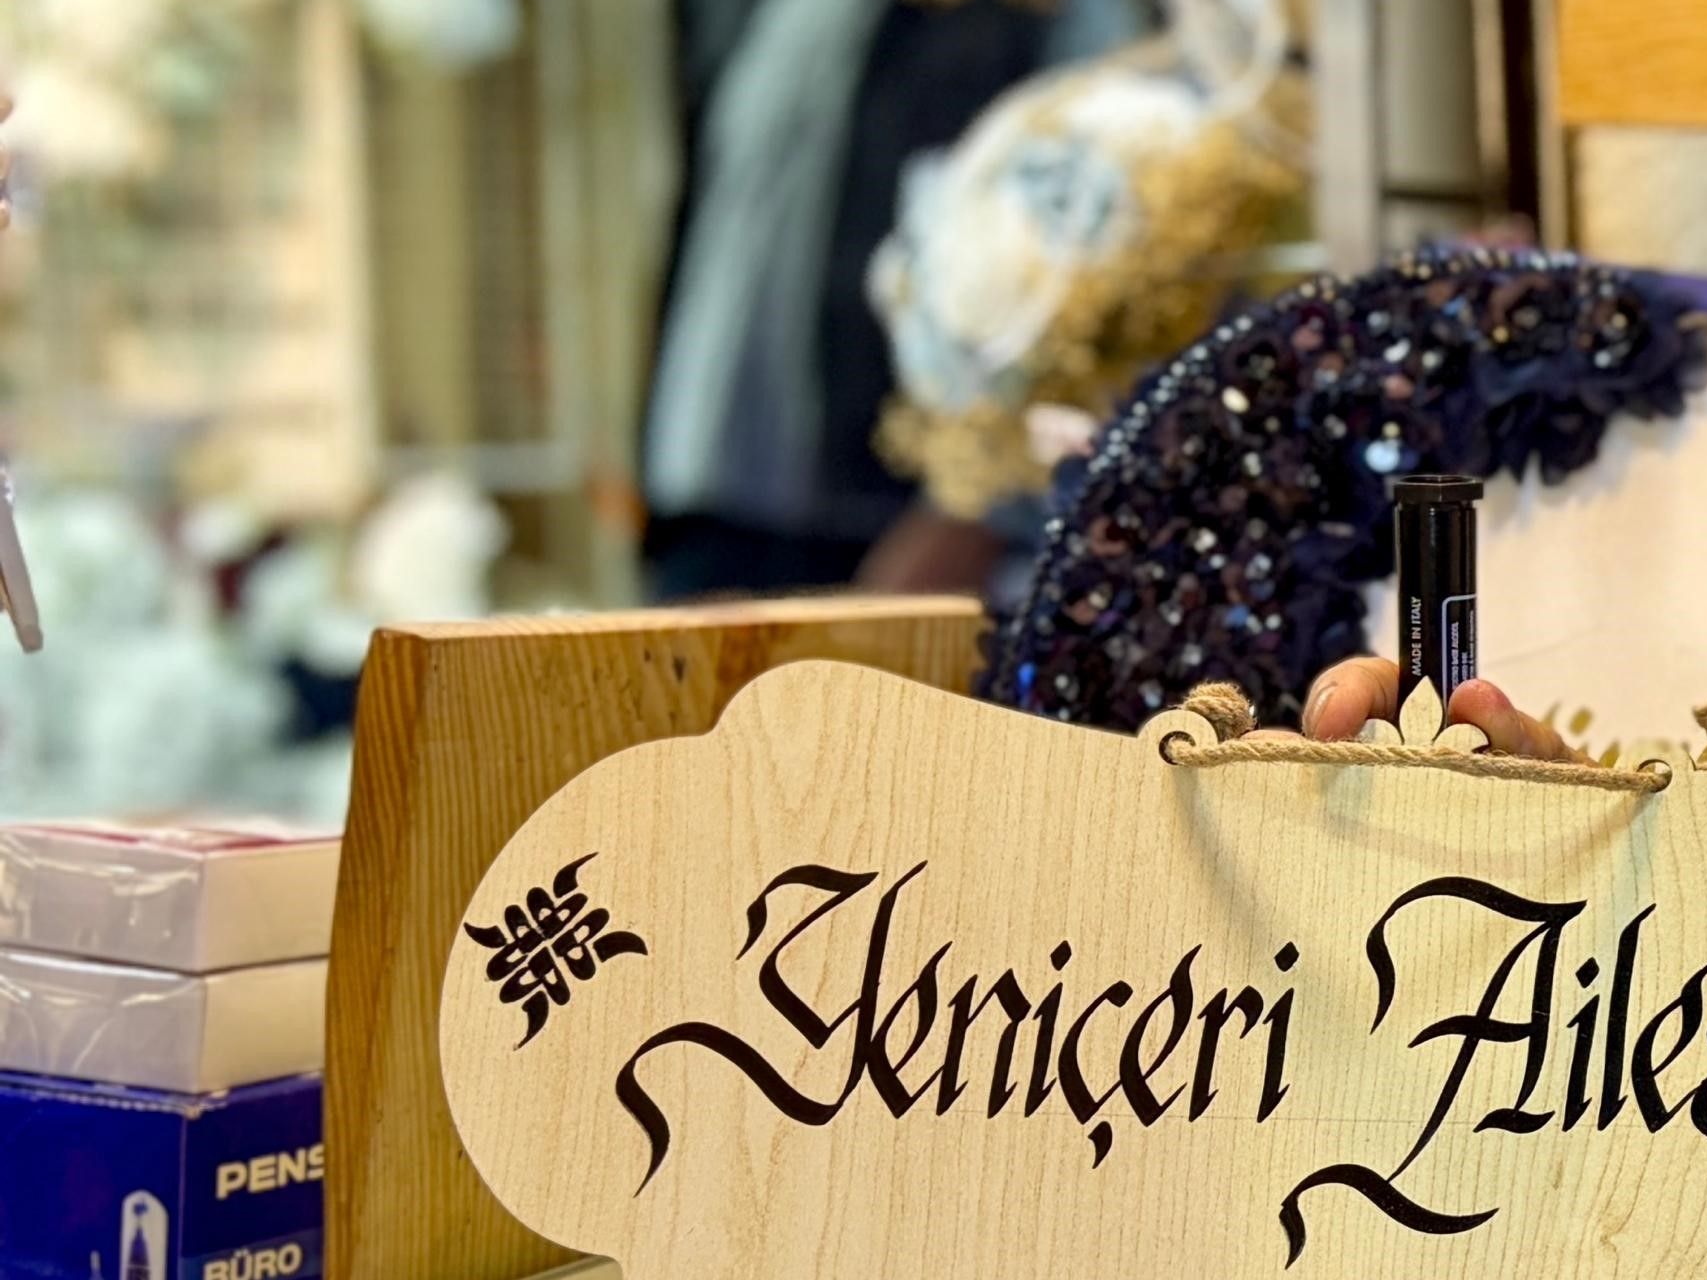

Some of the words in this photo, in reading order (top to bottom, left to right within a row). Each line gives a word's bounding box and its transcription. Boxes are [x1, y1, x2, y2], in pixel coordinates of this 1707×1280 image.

[1411, 596, 1422, 625] ITALY
[1411, 627, 1421, 639] IN
[1411, 642, 1422, 676] MADE
[614, 860, 1300, 1198] Yeniçeri
